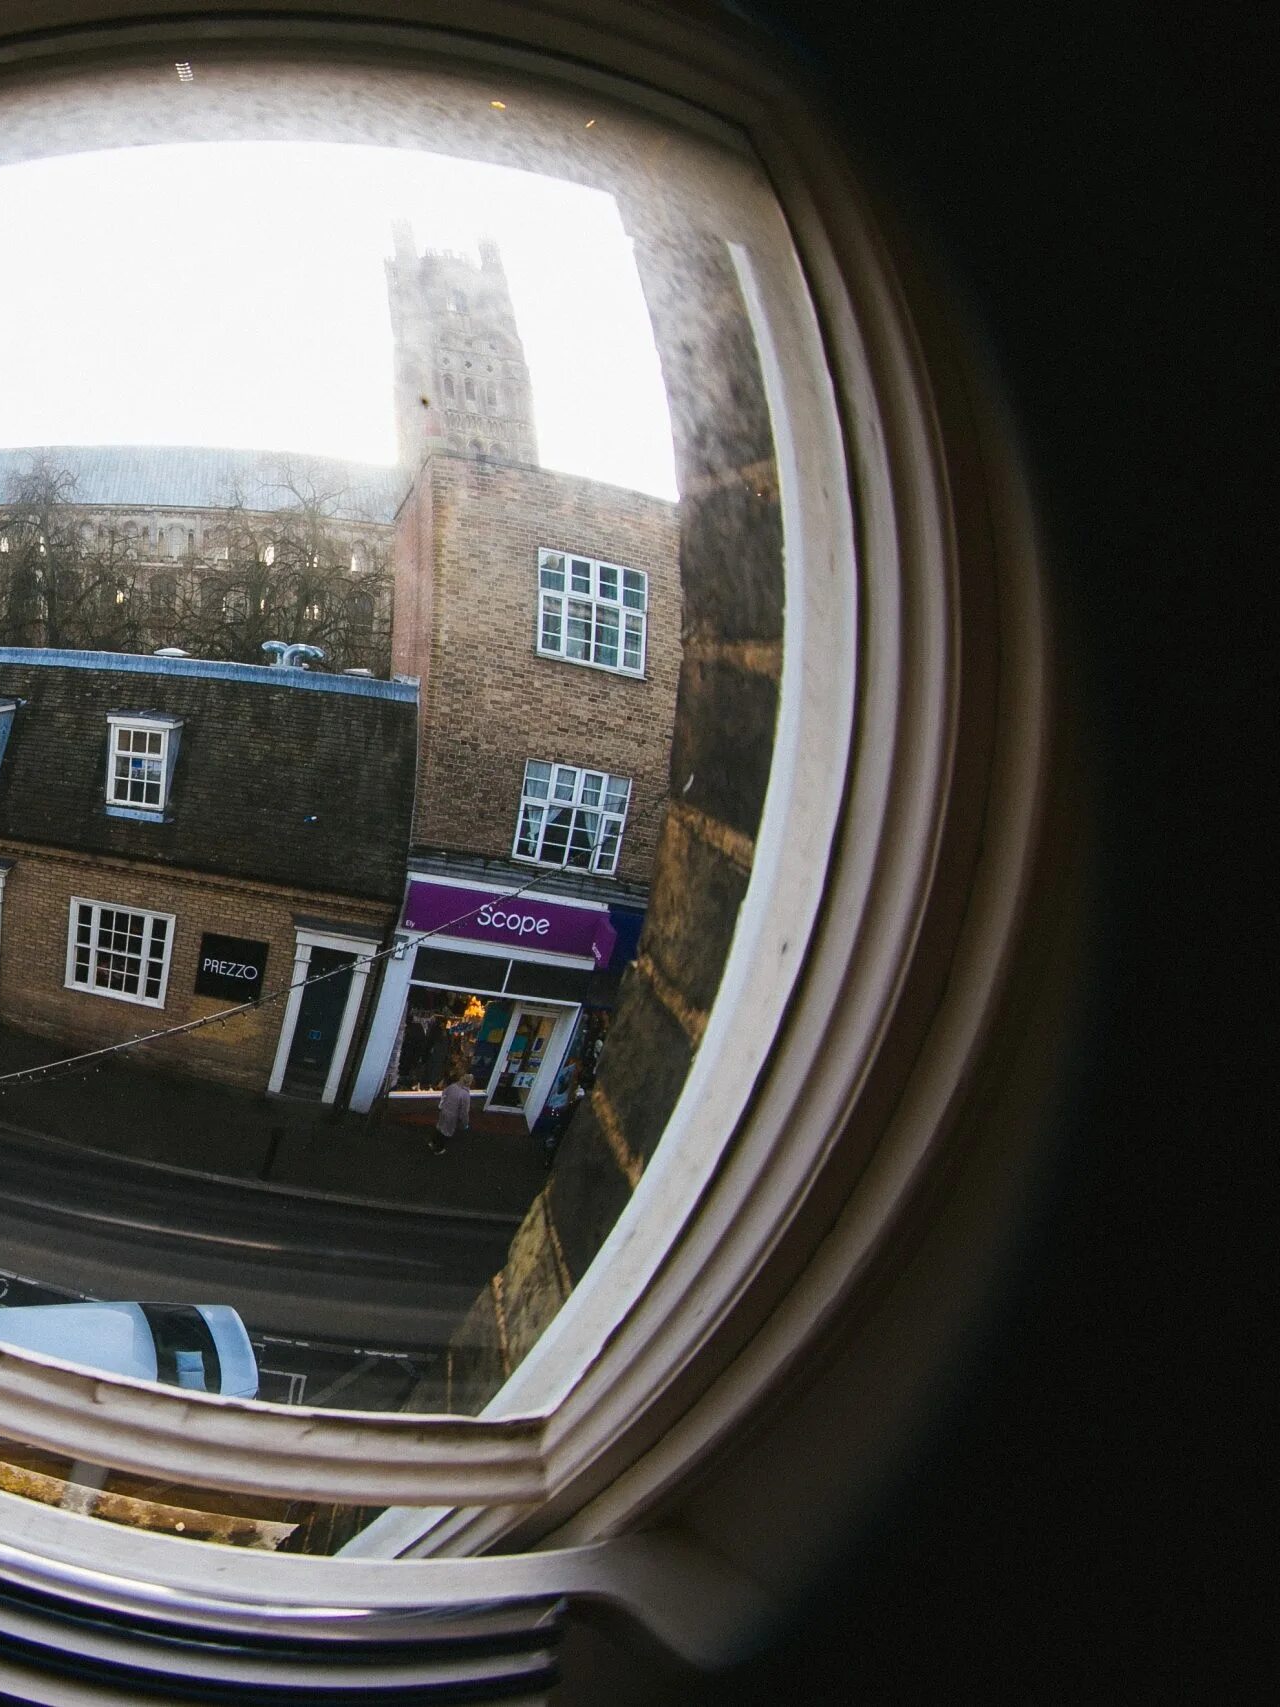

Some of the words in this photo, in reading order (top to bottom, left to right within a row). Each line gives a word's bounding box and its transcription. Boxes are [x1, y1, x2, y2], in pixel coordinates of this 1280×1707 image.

[405, 919, 416, 928] Ely
[477, 904, 551, 936] Scope
[203, 957, 258, 980] PREZZO
